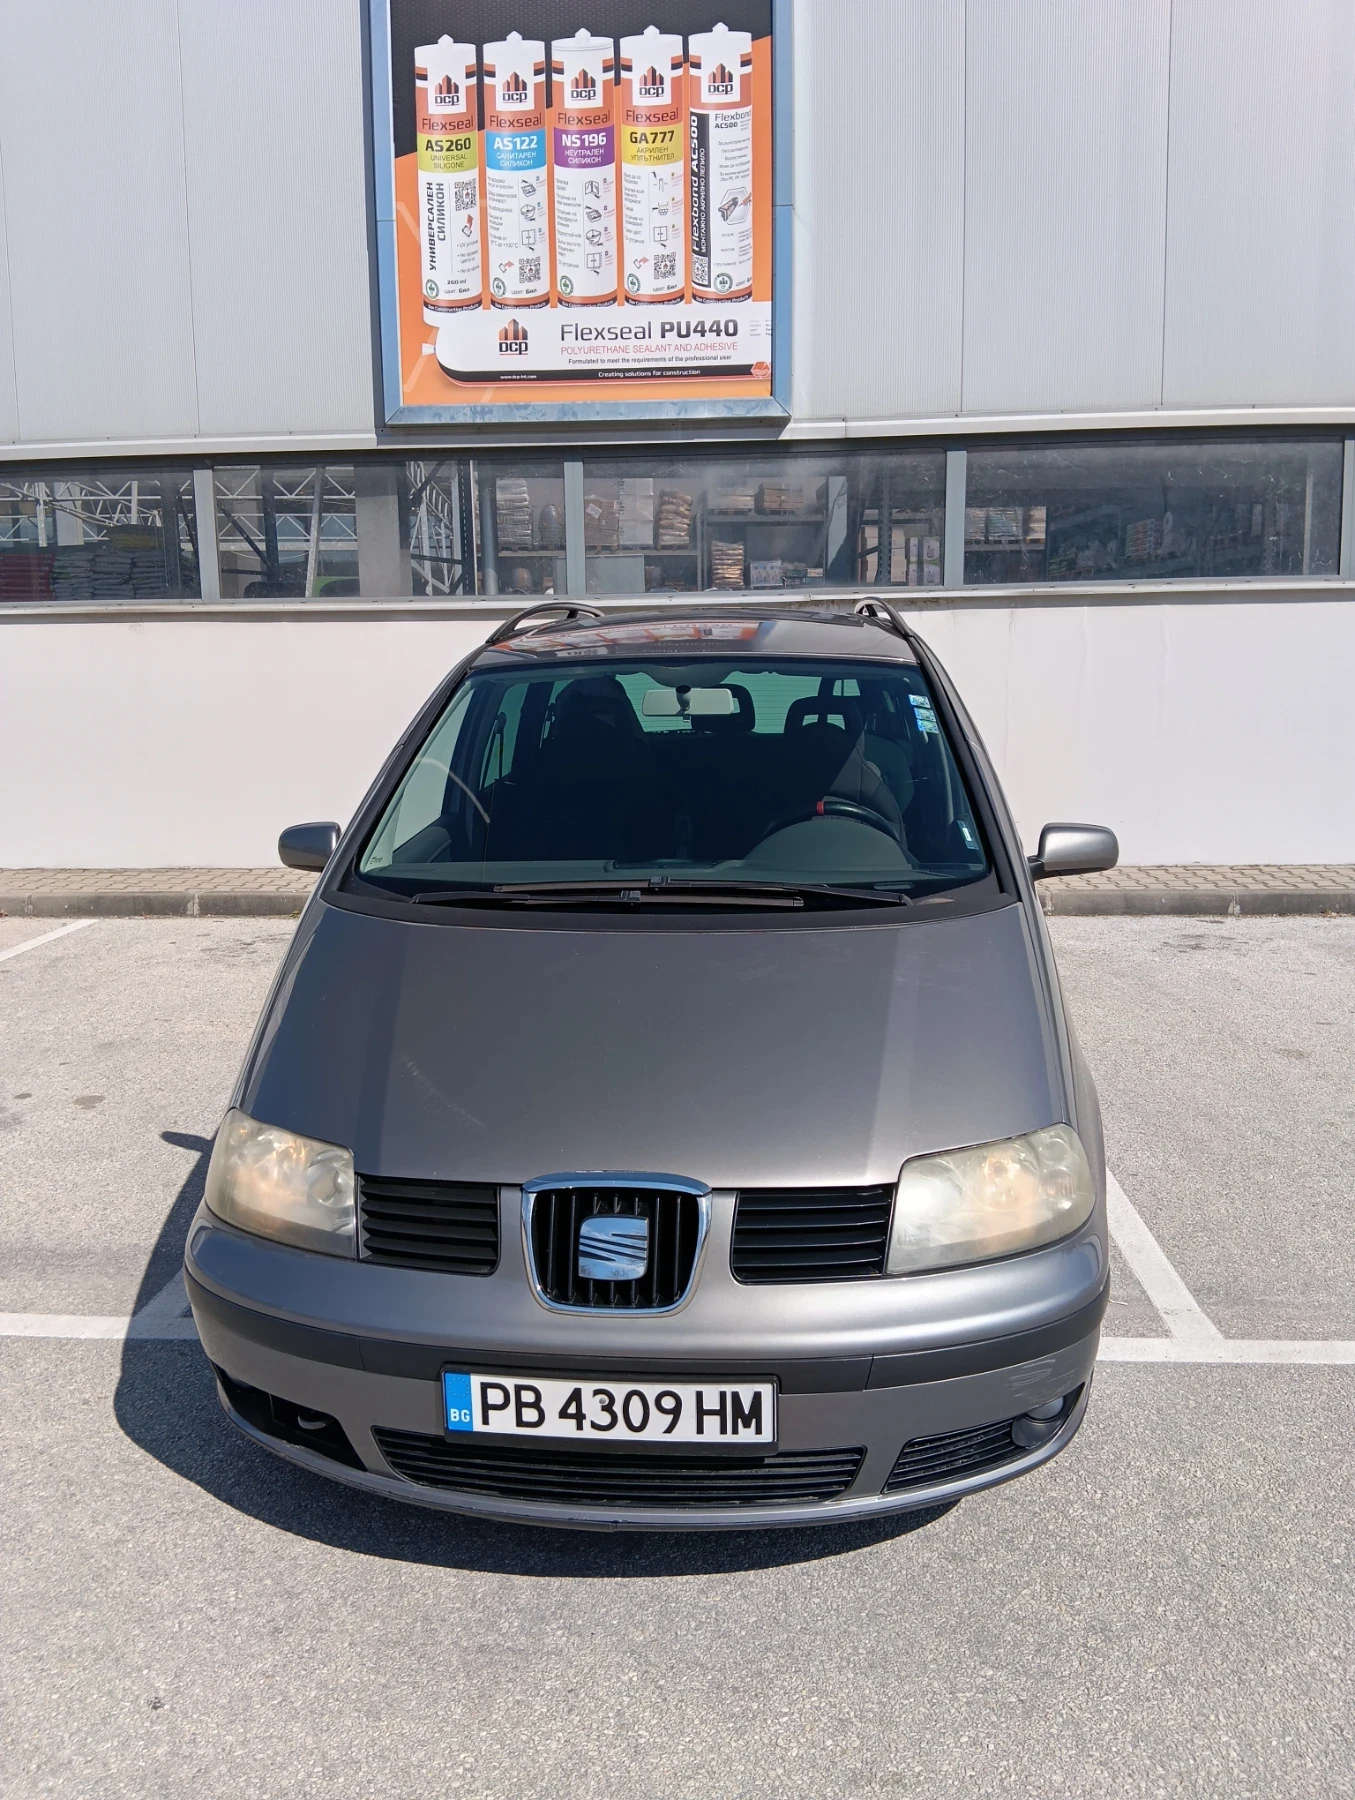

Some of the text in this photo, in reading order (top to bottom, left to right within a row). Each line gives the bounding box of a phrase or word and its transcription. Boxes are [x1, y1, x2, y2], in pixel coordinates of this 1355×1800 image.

[490, 113, 542, 128] Flexseal
[557, 110, 611, 125] Flexseal
[626, 107, 679, 122] Flexseal
[422, 115, 474, 131] Flexseal
[714, 121, 738, 129] AC500
[493, 135, 538, 150] AS122
[496, 151, 537, 159] САНИТАРЕН
[564, 148, 604, 156] НЕУТРАЛЕН
[636, 146, 669, 154] АКРИЛЕН
[430, 153, 468, 162] UNIVERSAL
[499, 159, 533, 167] СИЛИКОН
[567, 156, 602, 164] СИЛИКОН
[630, 153, 675, 162] УПЛЪТНИТЕЛ
[433, 161, 465, 169] SILICONE
[690, 115, 699, 252] Flexbond AC500
[436, 182, 446, 241] СИЛИКОН
[426, 182, 437, 271] УНИВЕРСАЛЕН
[561, 321, 652, 342] Flexseal
[660, 319, 738, 339] PU440
[561, 341, 738, 355] POLYURETHANE SEALANT AND ADHESIVE
[631, 356, 667, 364] requirements
[684, 354, 719, 363] professional
[479, 1381, 763, 1435] PB 4309 HM
[450, 1408, 471, 1423] BG
